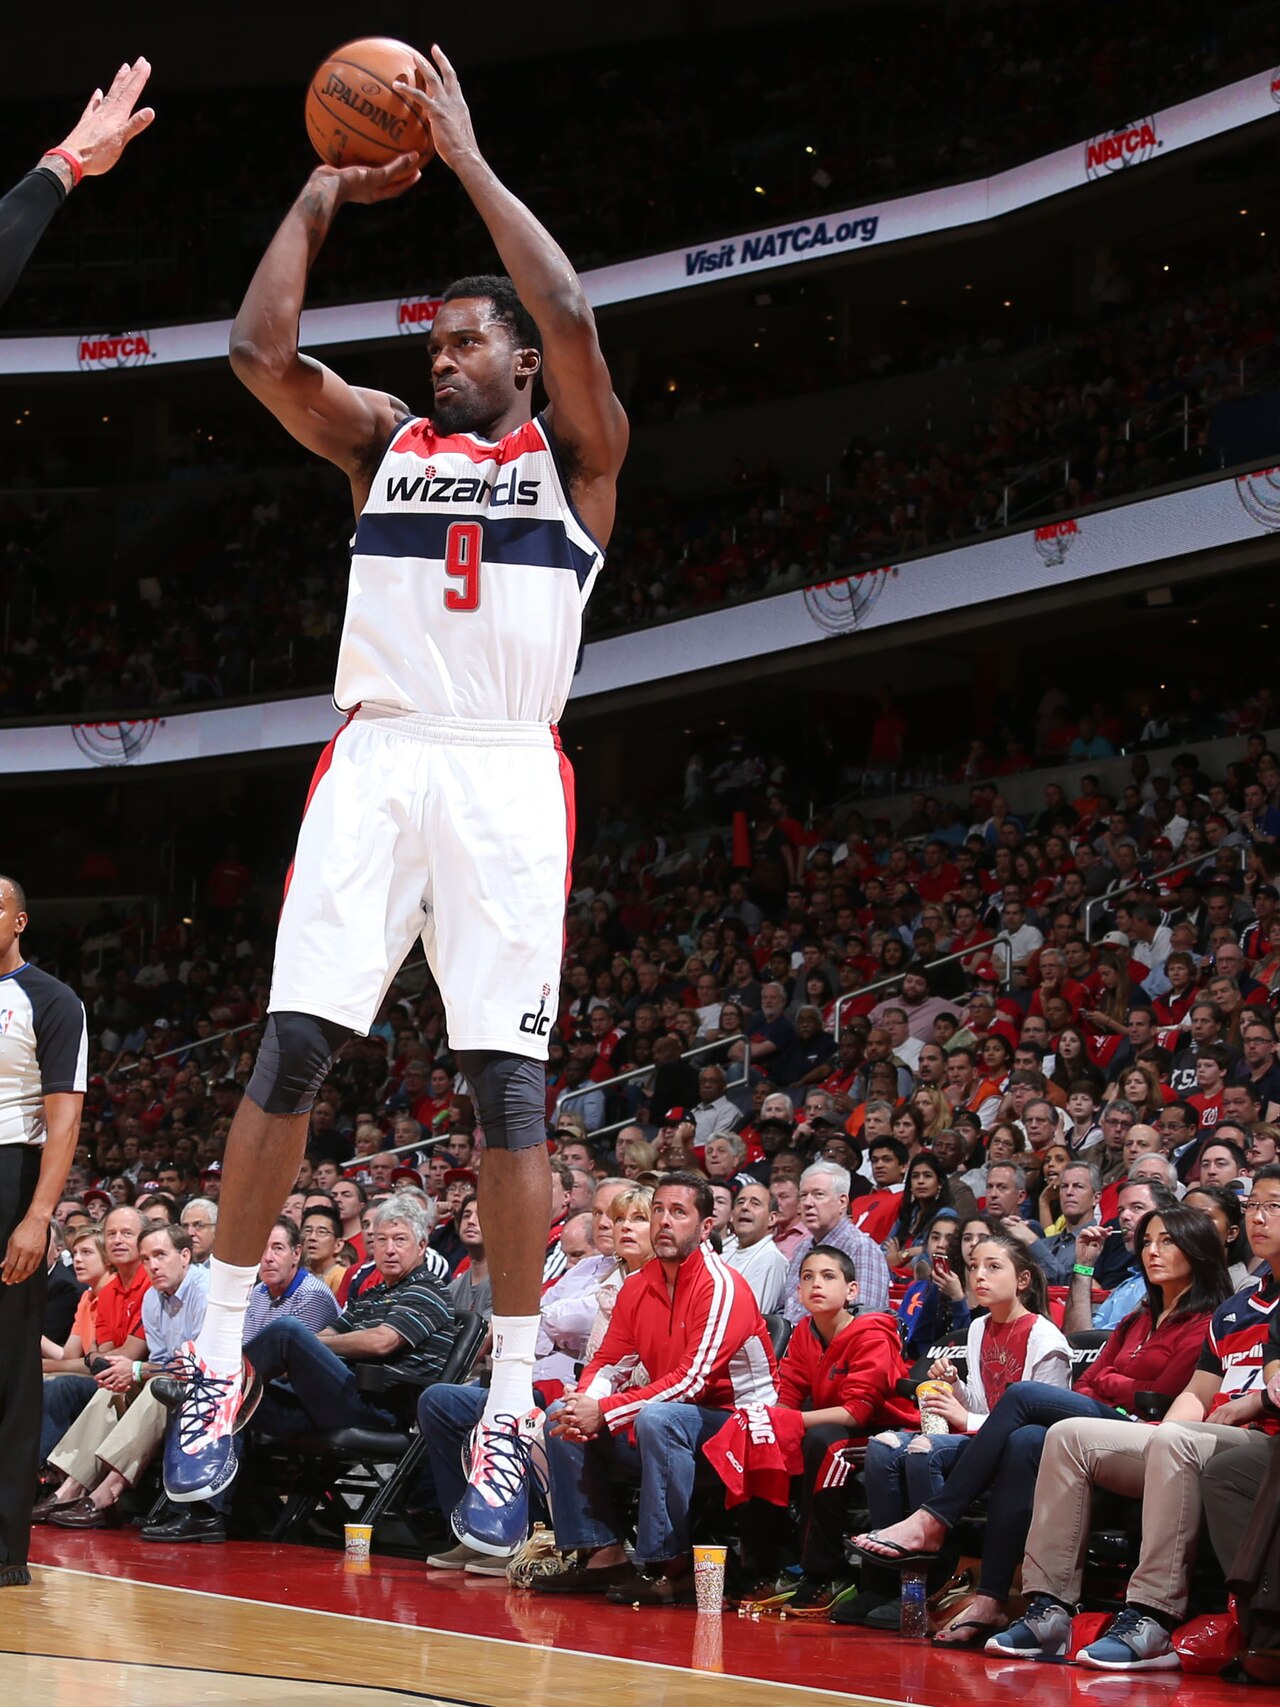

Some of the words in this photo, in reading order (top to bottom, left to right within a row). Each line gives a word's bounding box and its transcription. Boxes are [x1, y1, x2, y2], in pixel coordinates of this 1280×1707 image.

[322, 72, 407, 143] SPALDING
[1087, 124, 1156, 169] NATCA
[685, 244, 736, 276] Visit
[740, 216, 879, 264] NATCA.org
[399, 299, 444, 324] NAT
[80, 336, 151, 361] NATCA
[386, 465, 541, 507] wizards
[443, 521, 484, 613] 9
[926, 1341, 968, 1359] wiza
